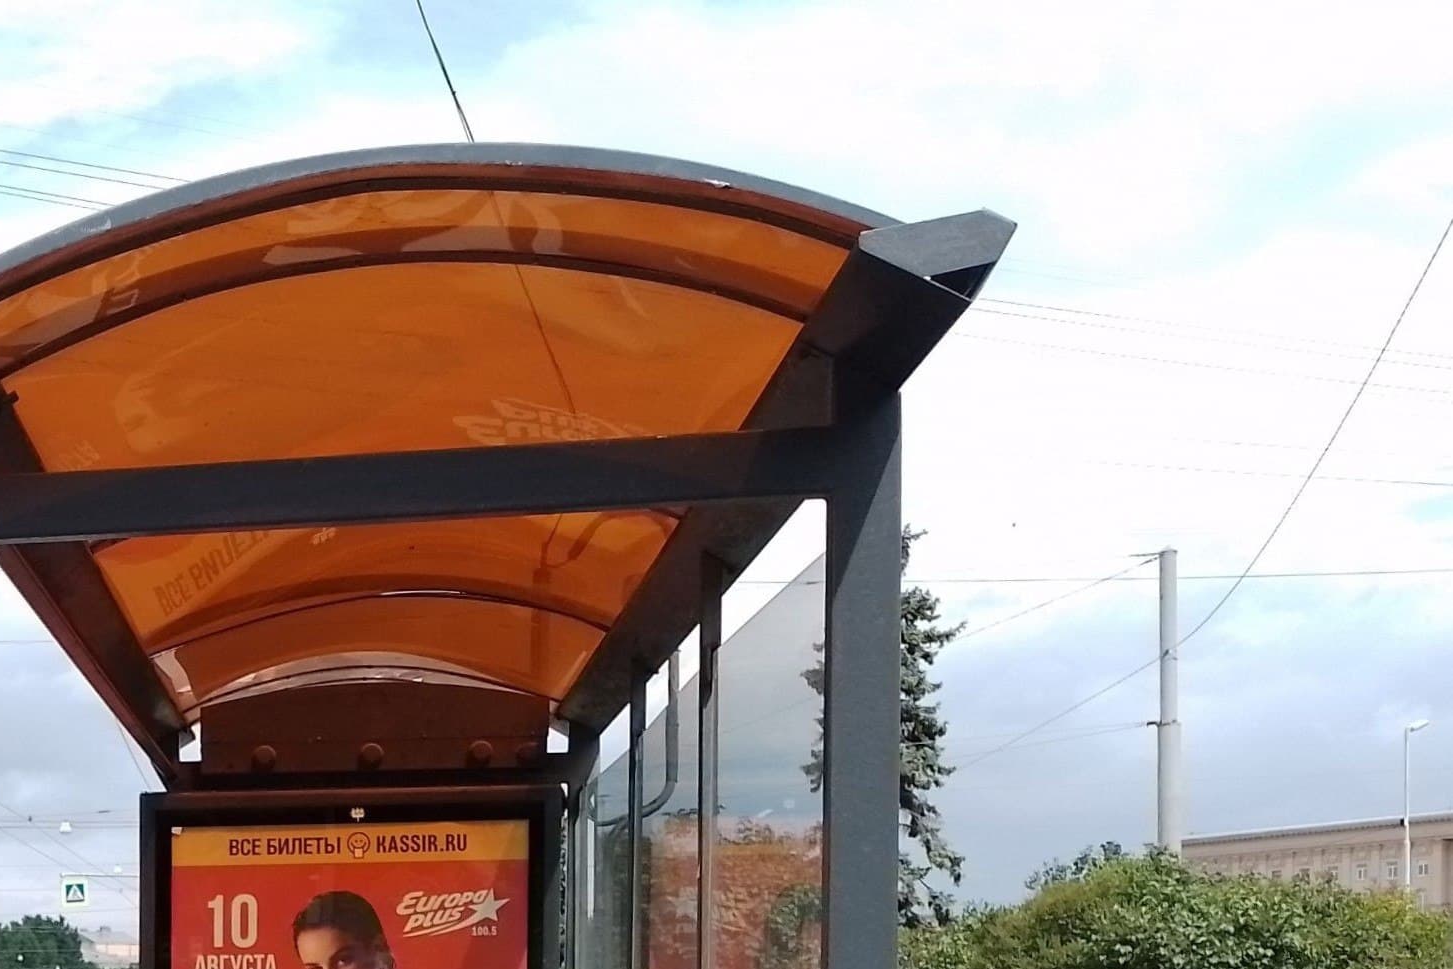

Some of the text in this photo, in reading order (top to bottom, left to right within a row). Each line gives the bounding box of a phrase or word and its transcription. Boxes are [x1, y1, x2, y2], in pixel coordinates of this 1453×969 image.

[229, 836, 341, 856] ВСЕ БИЛЕТЫ
[376, 833, 467, 853] KASSIR.RU
[208, 894, 258, 949] 10
[471, 925, 497, 936] 100.5
